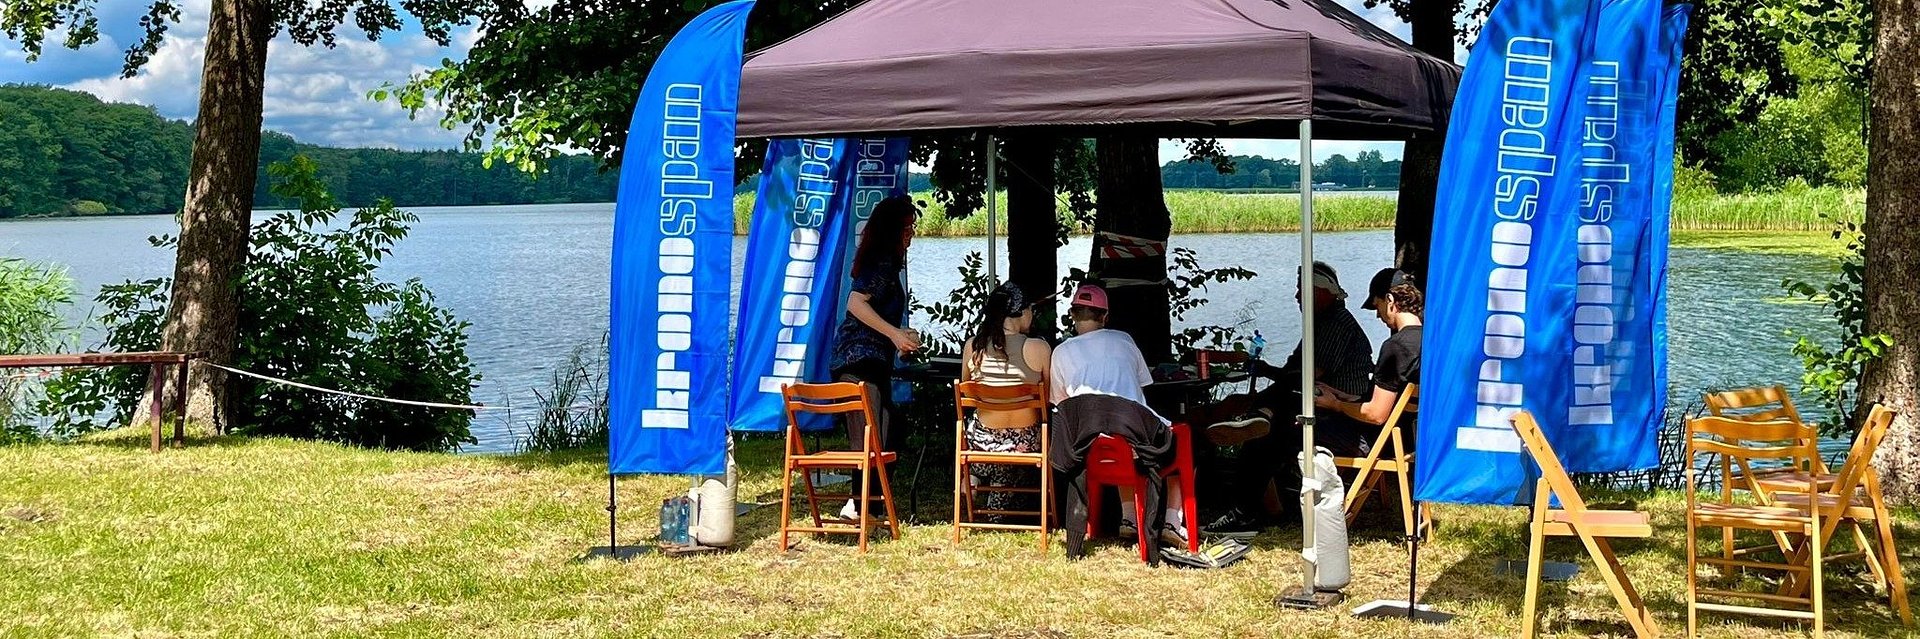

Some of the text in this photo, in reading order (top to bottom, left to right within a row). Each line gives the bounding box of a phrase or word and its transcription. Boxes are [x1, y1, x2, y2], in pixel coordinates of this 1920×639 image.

[642, 83, 713, 429] kronospan
[759, 138, 838, 393] kronospa
[1456, 35, 1556, 453] kronospan
